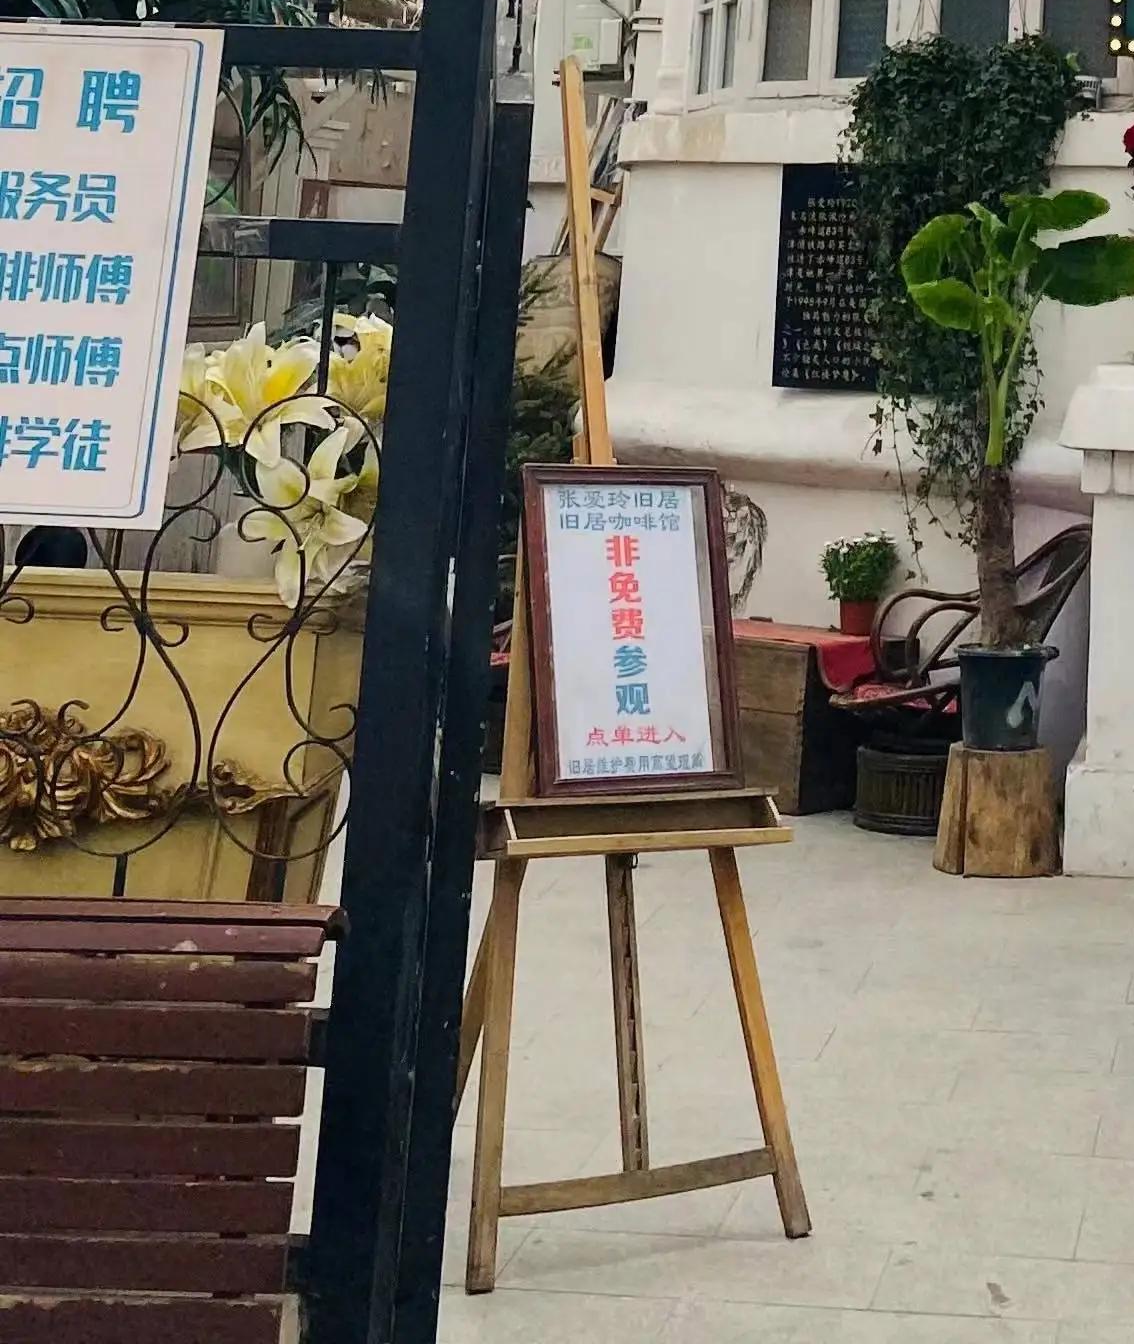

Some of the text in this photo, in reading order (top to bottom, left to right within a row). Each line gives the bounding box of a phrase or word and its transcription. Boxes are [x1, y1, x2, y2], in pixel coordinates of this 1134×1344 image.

[0, 415, 112, 472] 学徒
[558, 489, 680, 510] 张爱玲旧居
[559, 513, 681, 532] 旧居咖啡馆
[605, 535, 651, 715] 非免费参观
[586, 726, 686, 747] 点单进入
